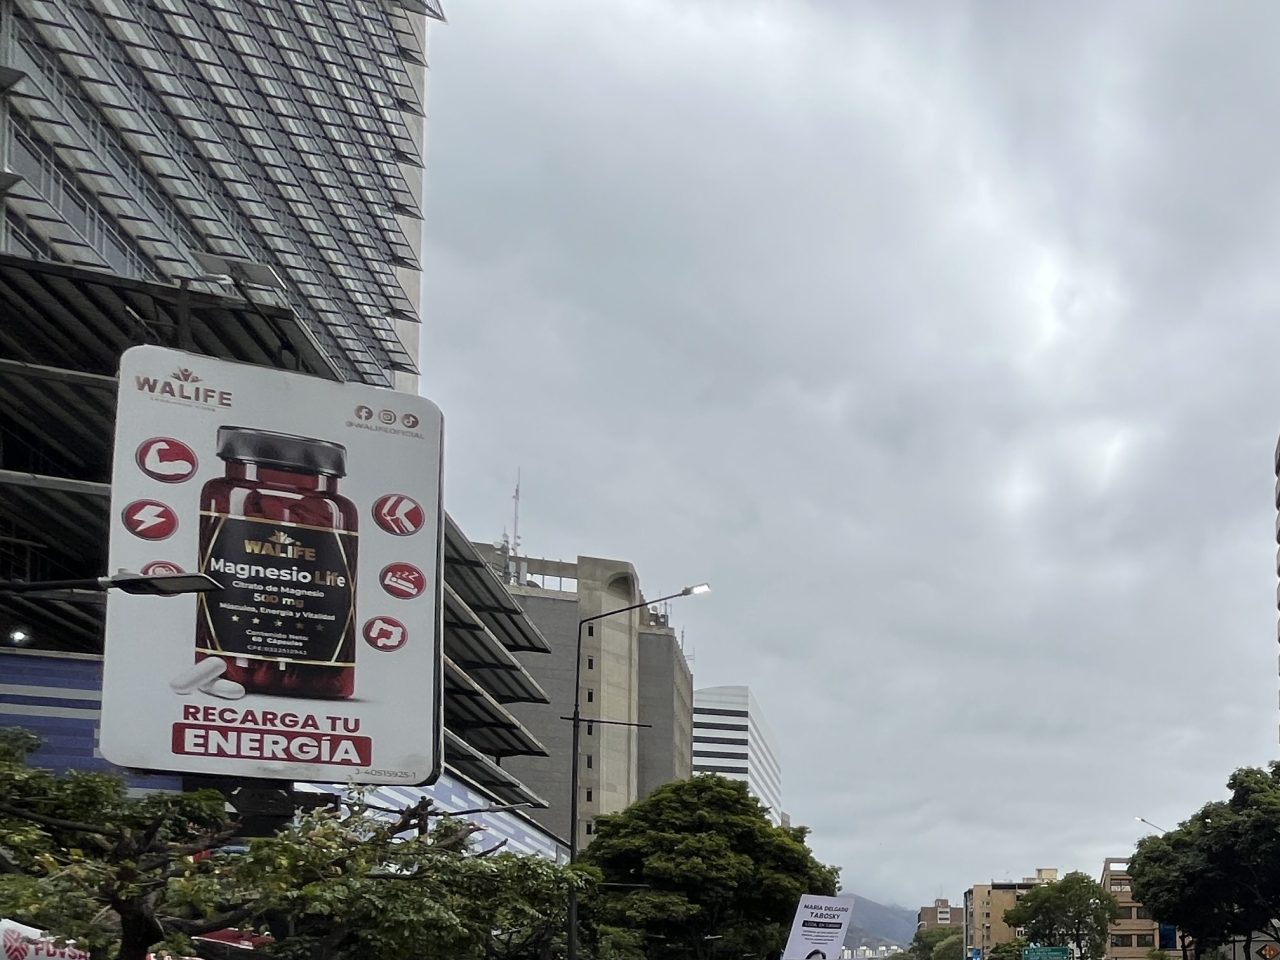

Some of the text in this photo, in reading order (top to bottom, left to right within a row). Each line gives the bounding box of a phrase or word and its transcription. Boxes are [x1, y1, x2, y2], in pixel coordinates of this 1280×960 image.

[135, 375, 232, 407] WALIFE
[243, 539, 317, 561] WALIFE
[210, 558, 346, 587] Magnesio Life
[232, 580, 325, 598] Citrato de Magnesio
[253, 593, 305, 608] 500 mg
[260, 606, 294, 617] Energía
[302, 611, 336, 621] Vitalidad
[183, 704, 360, 733] RECARGA TU
[184, 728, 362, 764] ENERGÍA
[809, 911, 841, 920] TABOSKY
